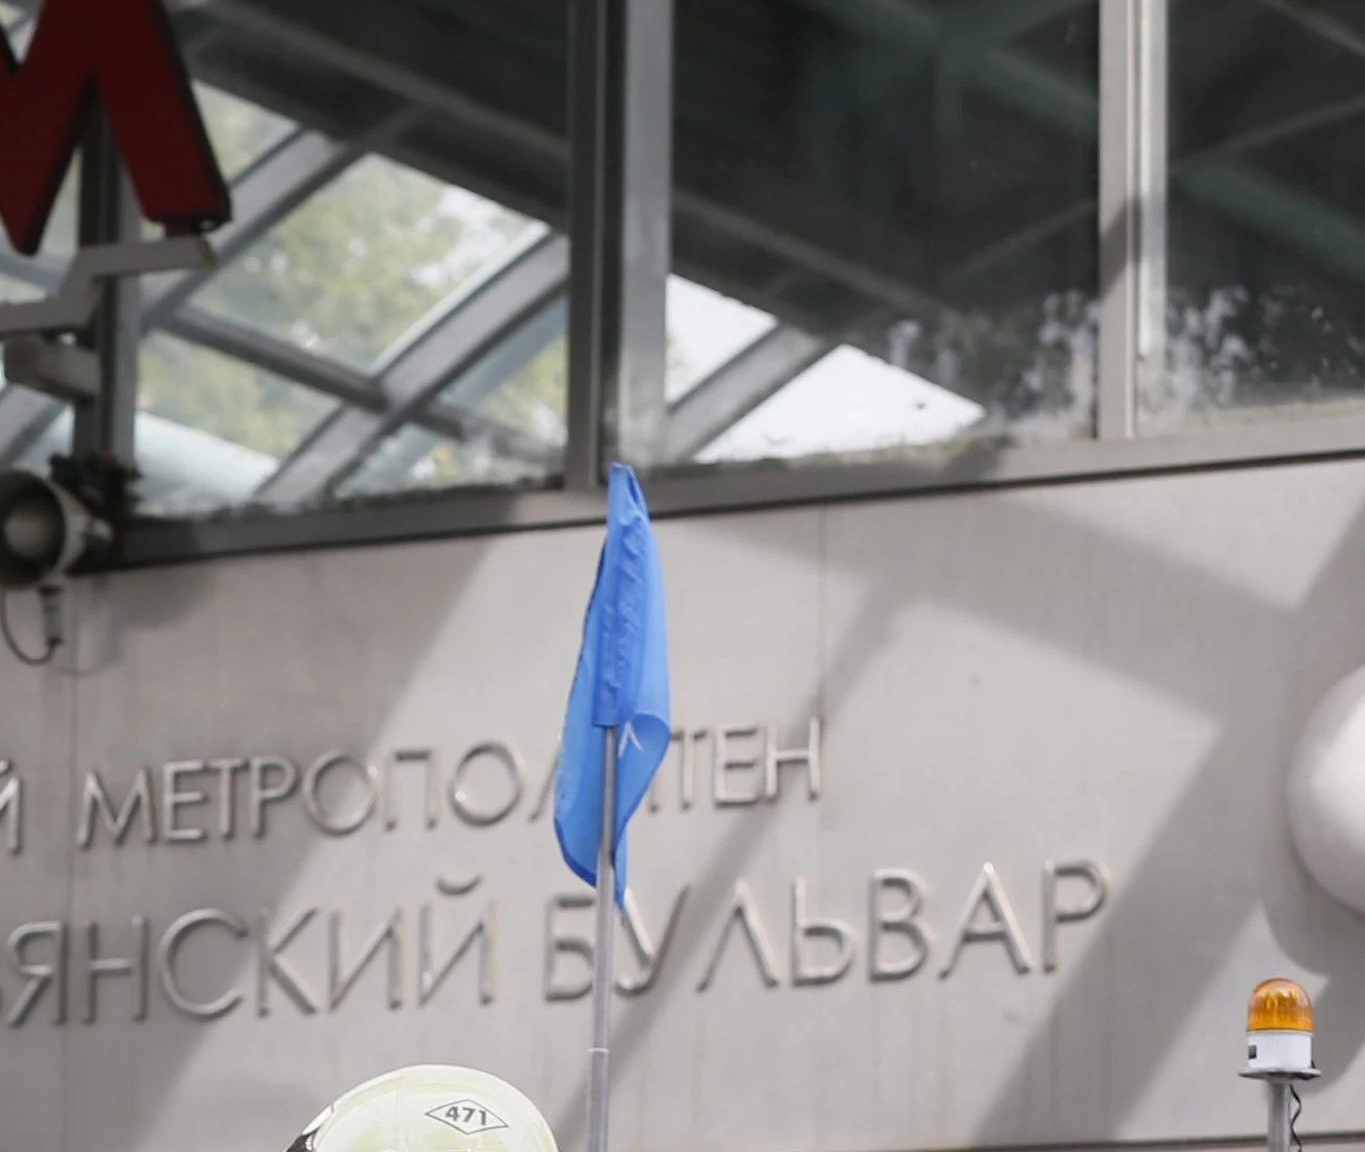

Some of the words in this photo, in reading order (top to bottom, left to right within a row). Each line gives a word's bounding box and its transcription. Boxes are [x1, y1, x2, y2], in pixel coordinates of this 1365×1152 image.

[76, 717, 825, 849] МЕТРОПОТЕН
[543, 858, 1114, 1003] БУЛЬВАР
[444, 1104, 488, 1126] 471
